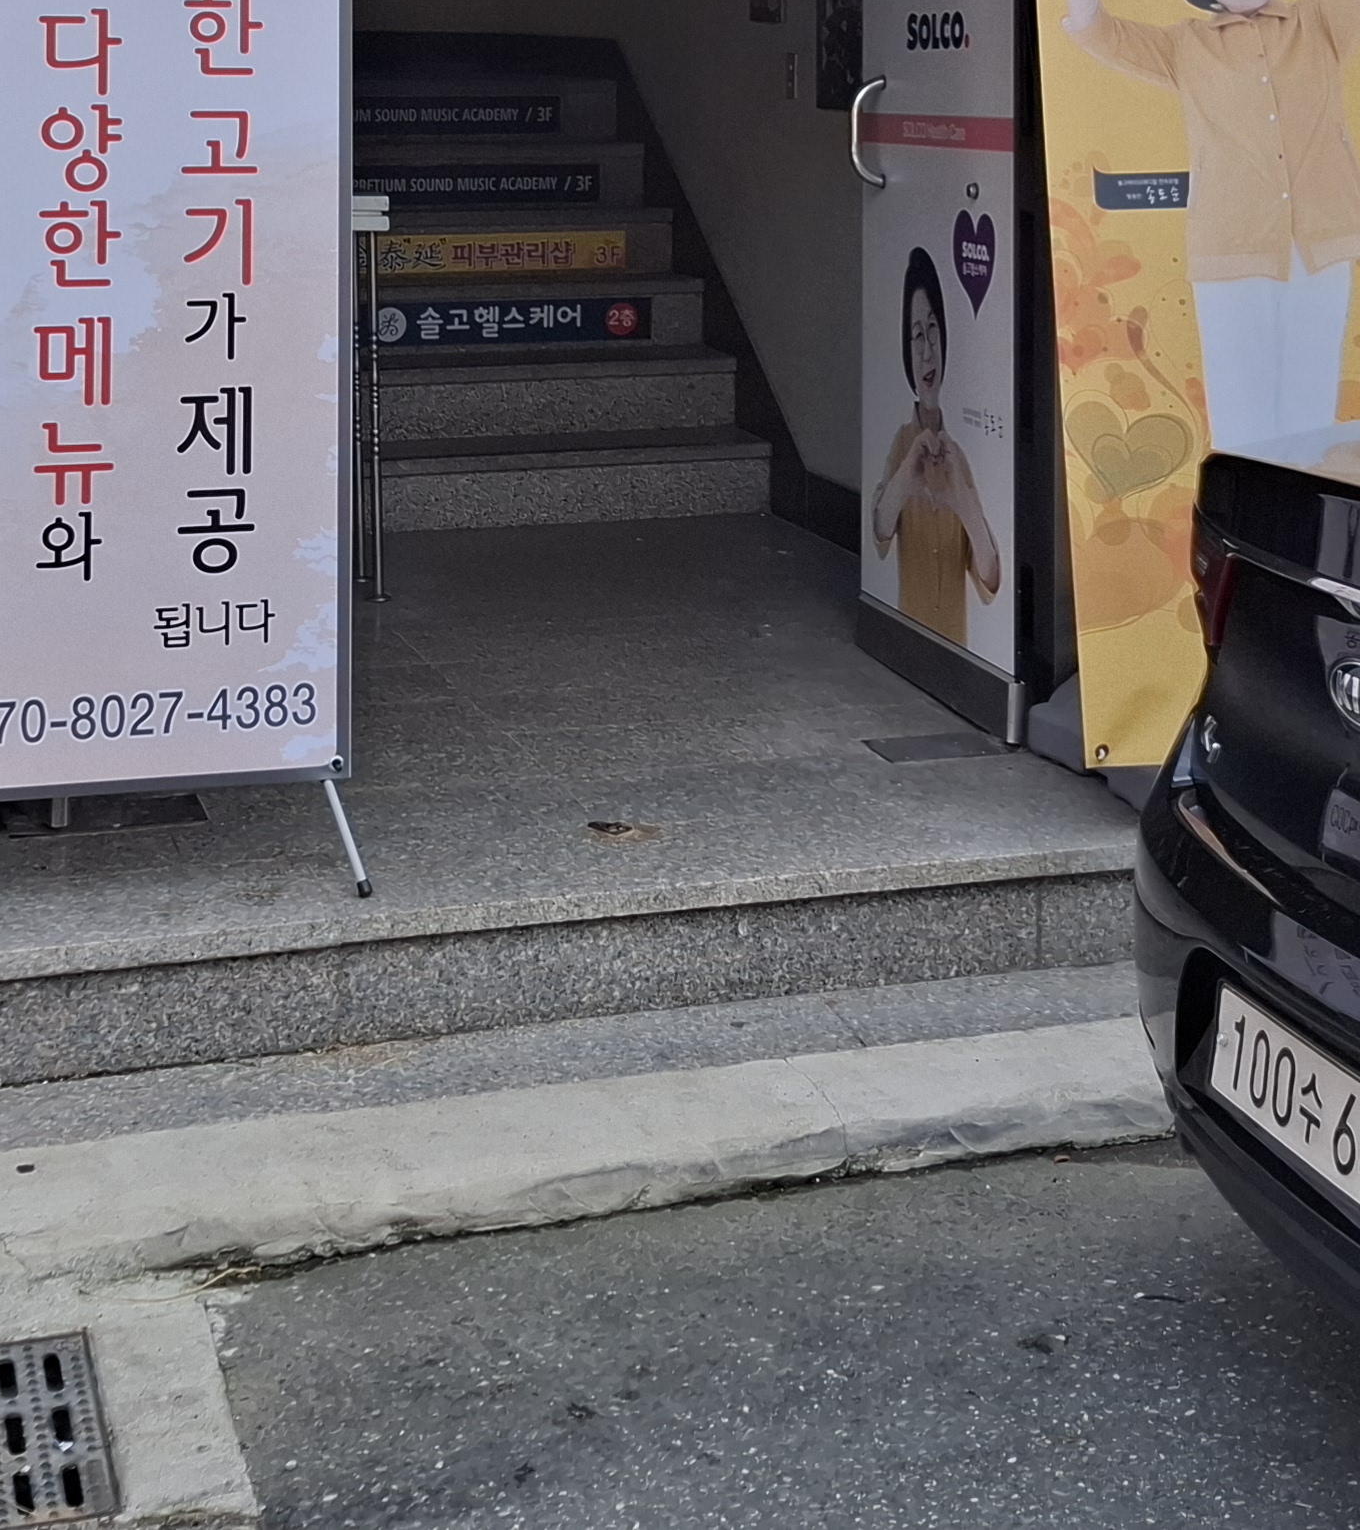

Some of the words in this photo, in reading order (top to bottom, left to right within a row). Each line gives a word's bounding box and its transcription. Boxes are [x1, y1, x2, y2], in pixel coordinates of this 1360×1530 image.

[375, 108, 417, 122] SOUND
[421, 108, 459, 121] MUSIC
[462, 108, 519, 121] ACADEMY
[537, 107, 553, 122] 3F
[38, 8, 123, 287] 다양한
[410, 178, 453, 192] SOUND
[457, 177, 495, 191] MUSIC
[499, 176, 557, 190] ACADEMY
[576, 175, 592, 191] 3F
[180, 110, 259, 360] 고기가
[451, 240, 577, 268] 피부관리샵
[594, 245, 622, 266] 3F
[415, 303, 582, 341] 솔고헬스케어
[607, 308, 633, 329] 2층
[34, 316, 114, 582] 메뉴와
[177, 386, 256, 574] 제공
[153, 599, 276, 648] 됩니다
